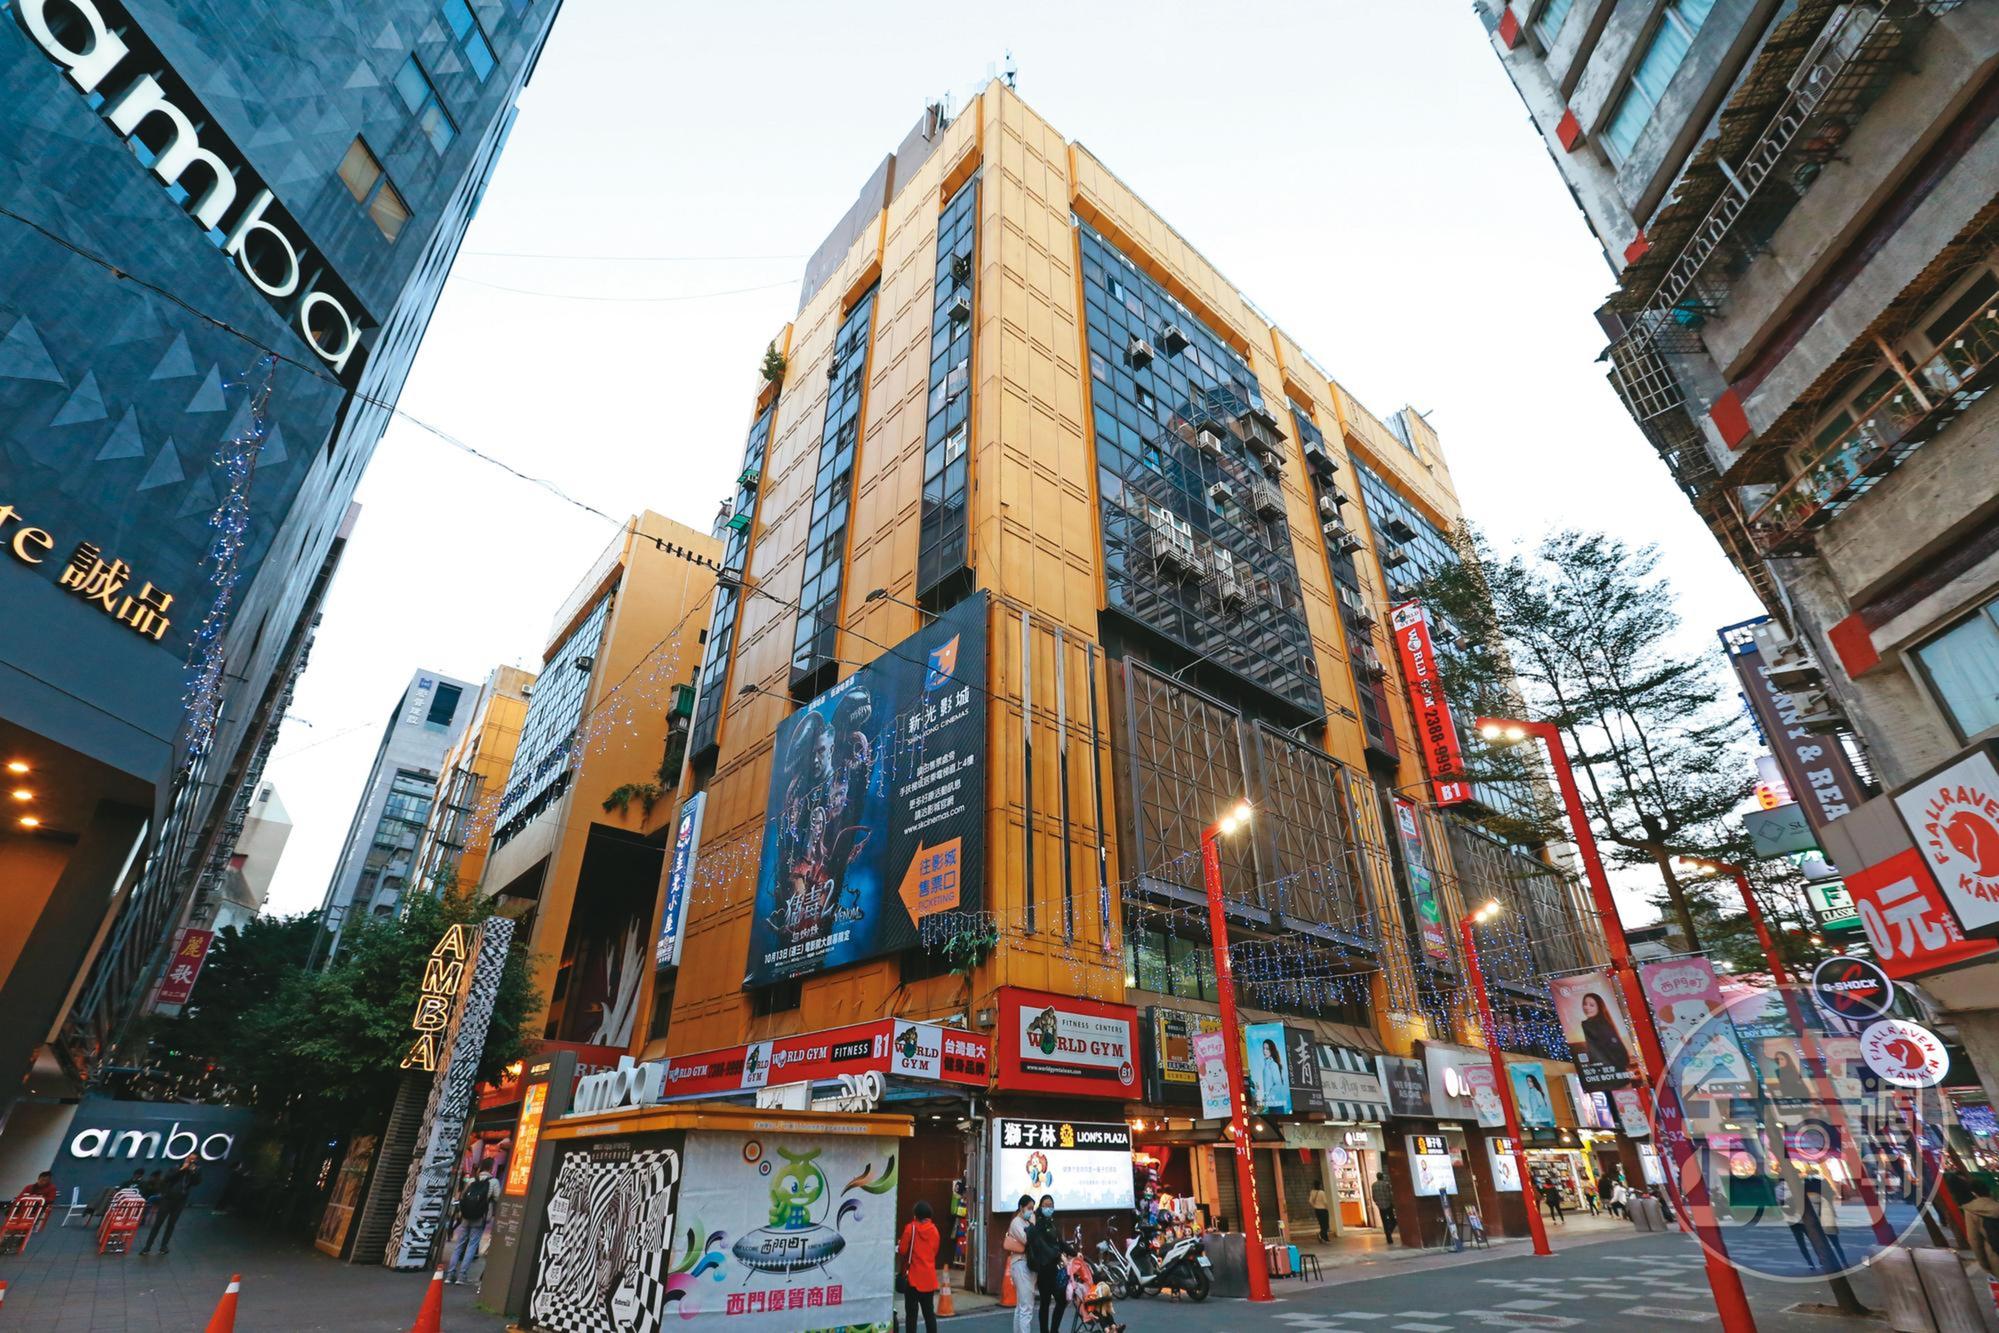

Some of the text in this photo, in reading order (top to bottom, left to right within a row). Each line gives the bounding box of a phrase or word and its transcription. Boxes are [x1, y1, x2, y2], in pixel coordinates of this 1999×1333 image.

[17, 0, 361, 374] amba
[60, 540, 174, 640] 誠品
[908, 685, 970, 734] 新光影城
[1441, 782, 1462, 801] B1
[918, 871, 956, 898] 售票口
[400, 923, 466, 1072] AMBA
[1822, 978, 1880, 992] G-SHOCK
[1062, 1019, 1122, 1033] FITNESS CENTERS
[806, 1046, 828, 1061] GYM
[834, 1042, 869, 1057] FITNESS
[873, 1033, 890, 1060] B1
[1090, 1041, 1124, 1058] GYM
[901, 1059, 929, 1071] GYM
[573, 1055, 664, 1113] amba
[1661, 1107, 1676, 1118] W
[70, 1122, 235, 1161] amba
[1004, 1121, 1057, 1147] 獅子林
[1076, 1131, 1128, 1144] LION'S PLAZA
[726, 1283, 843, 1316] 西門優質商圈
